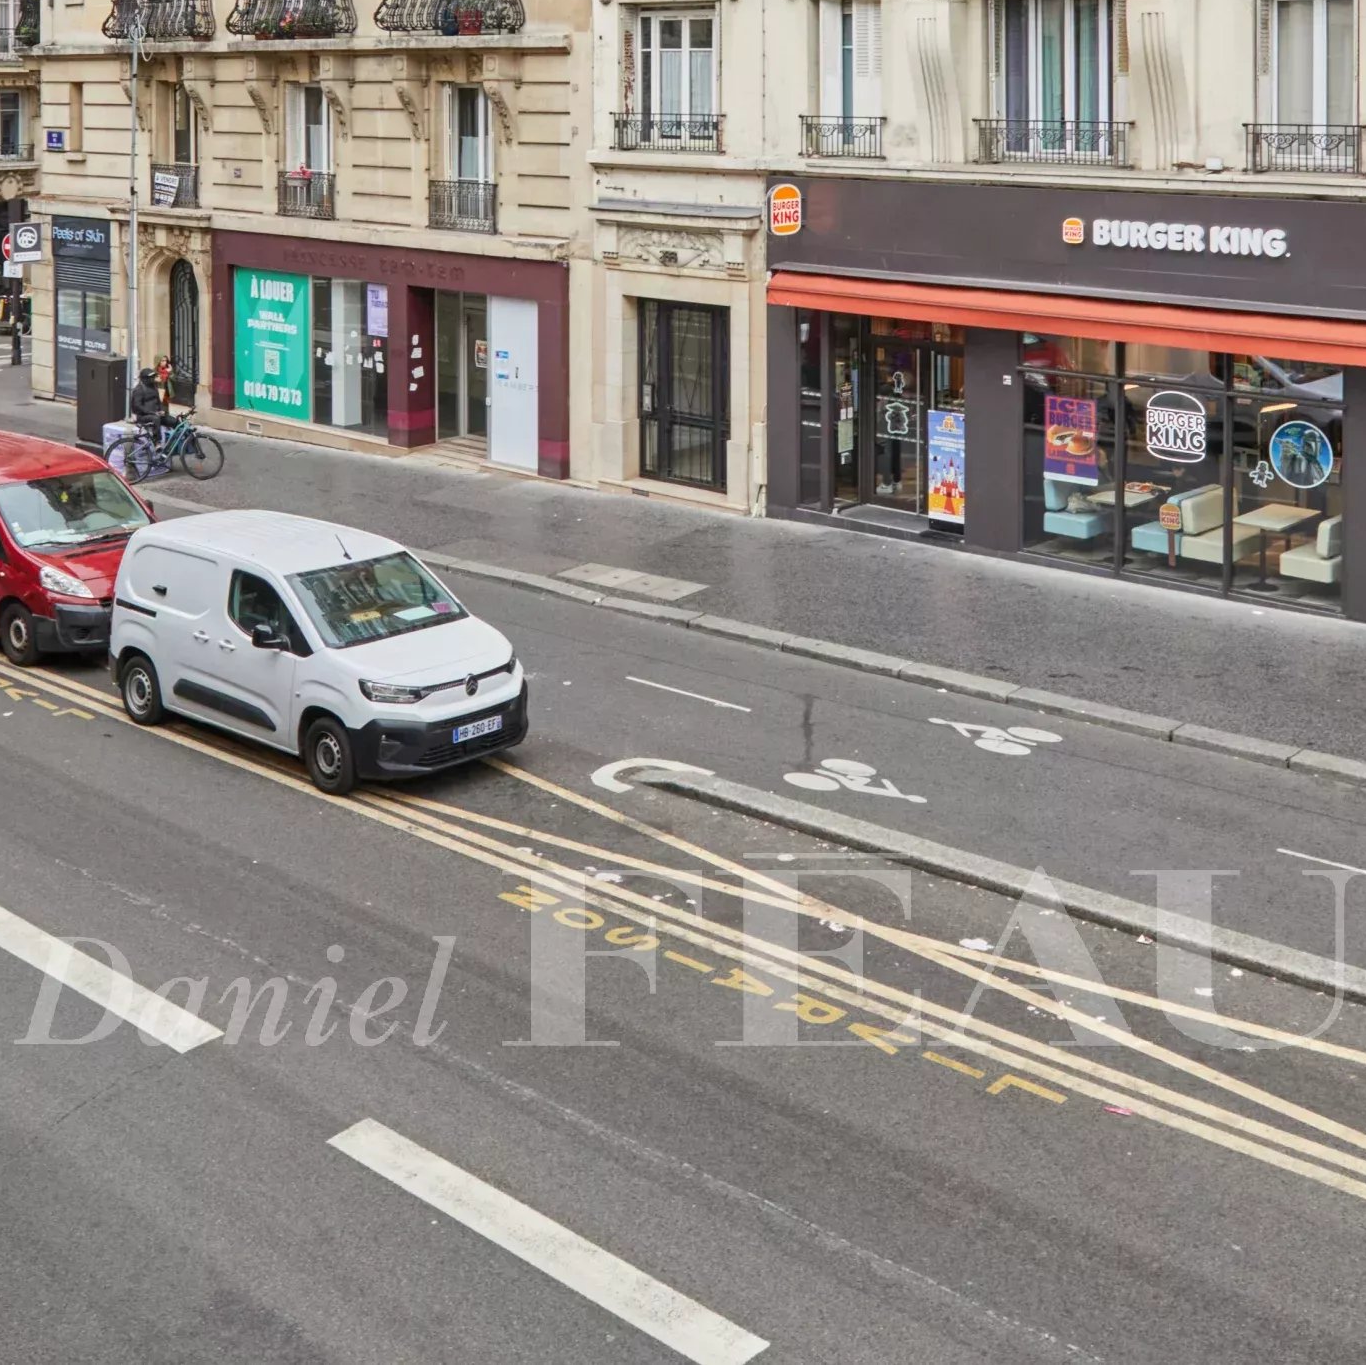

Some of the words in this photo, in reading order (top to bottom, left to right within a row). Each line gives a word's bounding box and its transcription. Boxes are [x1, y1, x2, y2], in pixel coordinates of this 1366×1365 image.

[772, 200, 800, 211] BURGER
[772, 210, 800, 225] KING
[52, 226, 74, 240] Peels
[75, 230, 86, 241] of
[86, 228, 105, 244] Skin
[1092, 219, 1205, 252] BURGER
[251, 275, 259, 299] À
[260, 279, 294, 303] LOUER
[259, 310, 285, 322] WALL
[247, 318, 297, 335] PARTNERS
[243, 380, 255, 397] 01
[1049, 398, 1092, 413] ICE
[1049, 412, 1092, 428] BURGER
[1147, 410, 1205, 431] BURGER
[1147, 425, 1205, 451] KING
[498, 885, 1068, 1104] LIVRAISON
